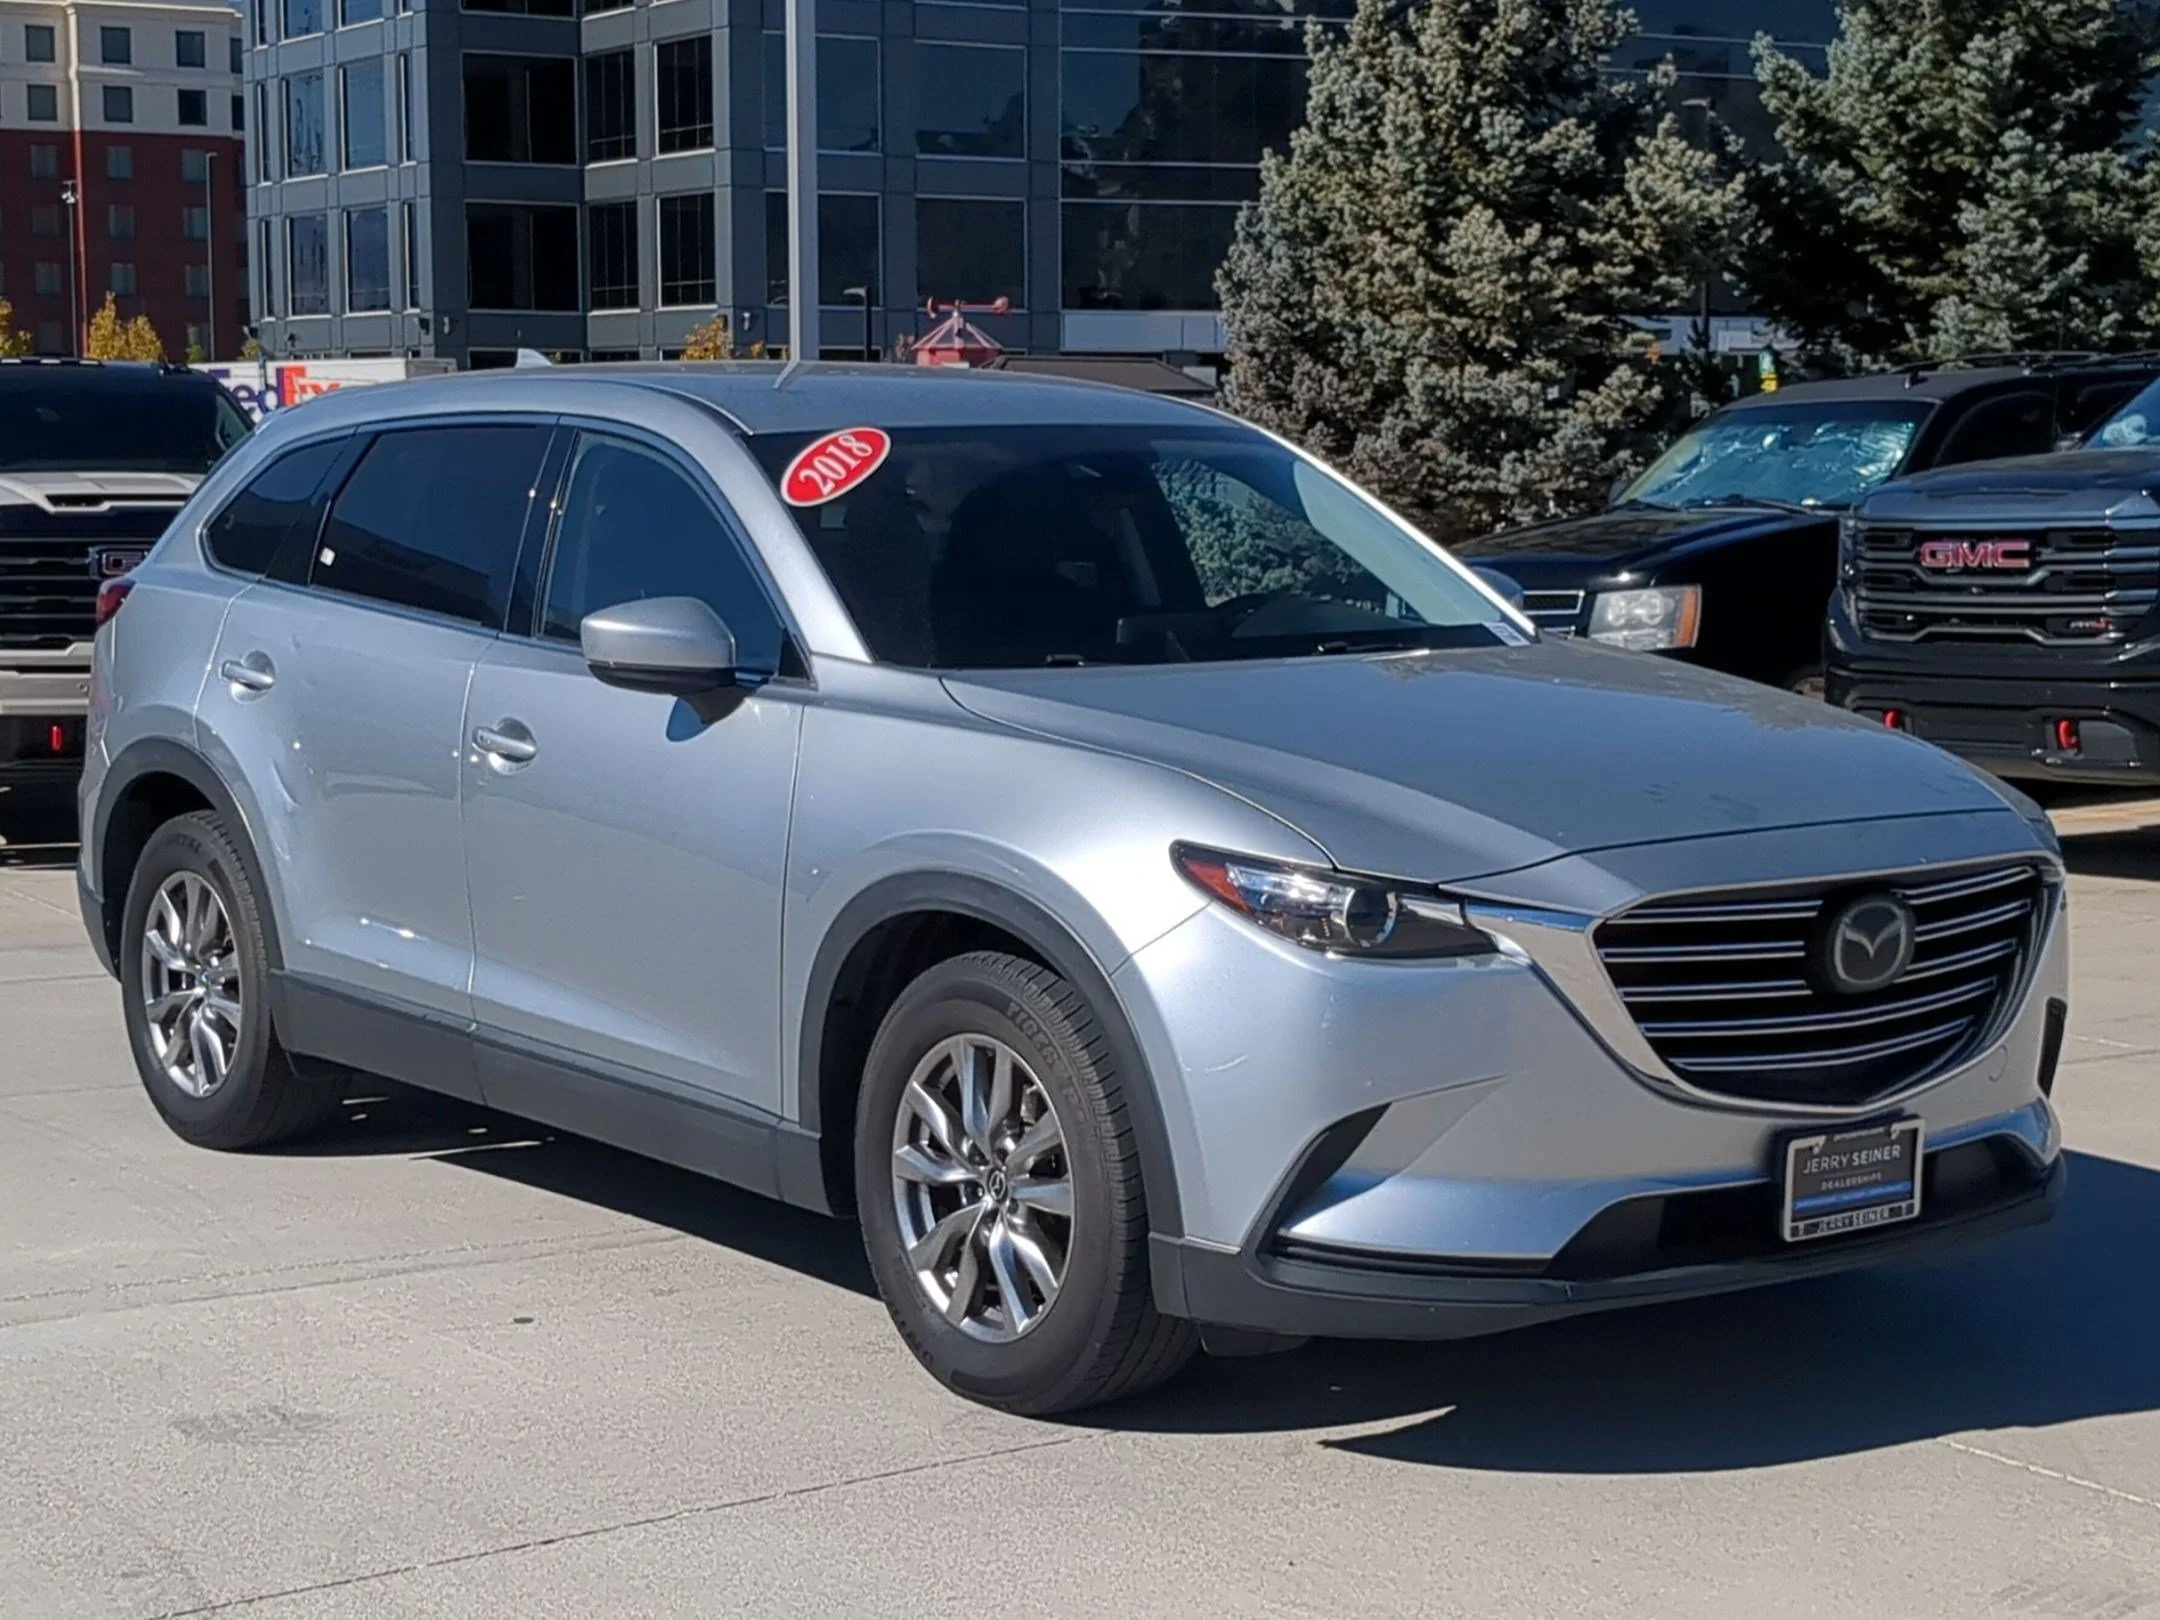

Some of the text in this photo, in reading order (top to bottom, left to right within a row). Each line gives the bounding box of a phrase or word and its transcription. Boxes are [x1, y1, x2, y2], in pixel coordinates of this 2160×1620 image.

[799, 434, 873, 496] 2018
[1921, 541, 2030, 568] GMC
[1803, 1145, 1900, 1174] JERRY SEINER
[1820, 1172, 1882, 1190] DEALERSHIPS
